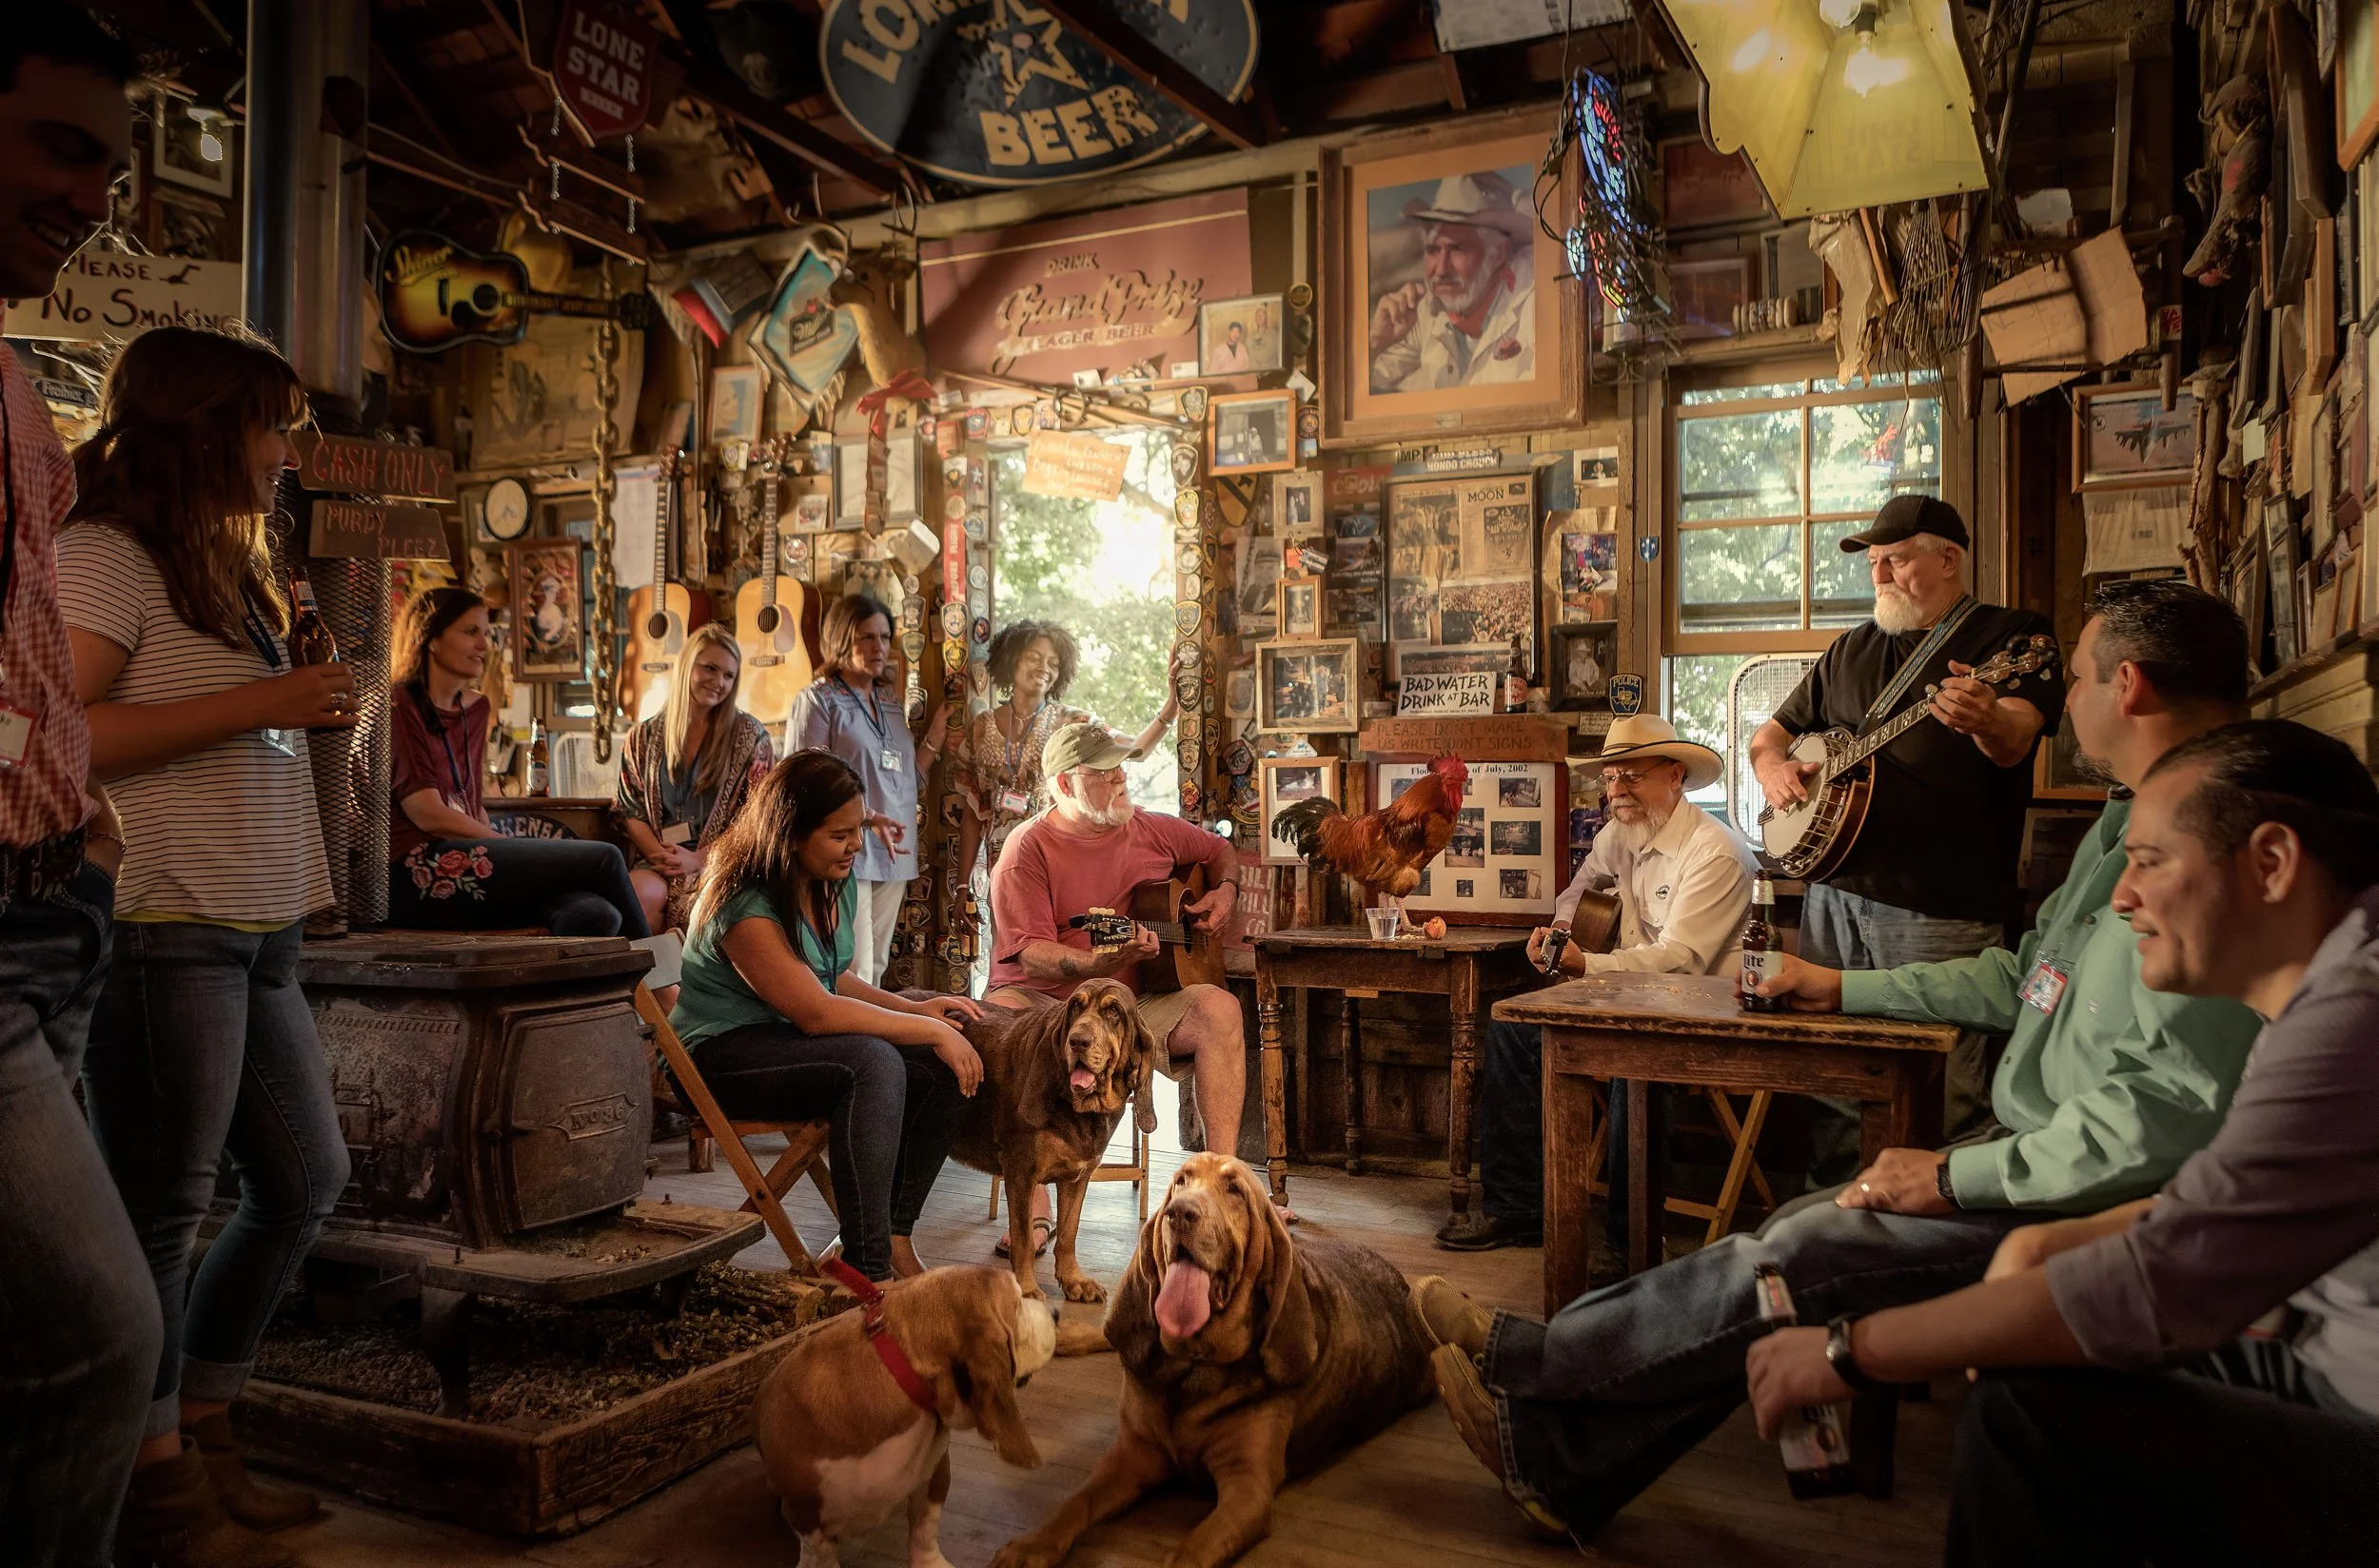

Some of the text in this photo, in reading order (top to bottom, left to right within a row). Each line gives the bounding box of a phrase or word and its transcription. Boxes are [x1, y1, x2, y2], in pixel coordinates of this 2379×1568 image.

[573, 9, 646, 73] LONE
[842, 0, 979, 85] LON
[566, 45, 639, 106] STAR
[979, 84, 1160, 167] BEER
[1045, 252, 1100, 277] DRINK
[994, 269, 1204, 352] Grand Prize
[1106, 327, 1155, 346] BEER
[312, 441, 446, 498] CASH ONLY
[1426, 456, 1498, 473] HONDO CROUCH
[1468, 489, 1504, 502] MOON
[326, 504, 388, 535] PURDY
[378, 534, 438, 558] PLEEZ
[1405, 676, 1435, 693] BAD
[1436, 675, 1488, 692] WATER
[1613, 676, 1639, 688] POLICE
[1401, 691, 1490, 710] DRINK AT BAR
[1377, 722, 1427, 736] PLEASE
[1484, 720, 1524, 734] MAKE
[1377, 737, 1395, 750] US
[1401, 737, 1442, 750] WRITE
[1488, 735, 1532, 750] SIGNS
[1471, 765, 1482, 774] of
[1484, 765, 1505, 774] July,
[1507, 764, 1528, 773] 2002
